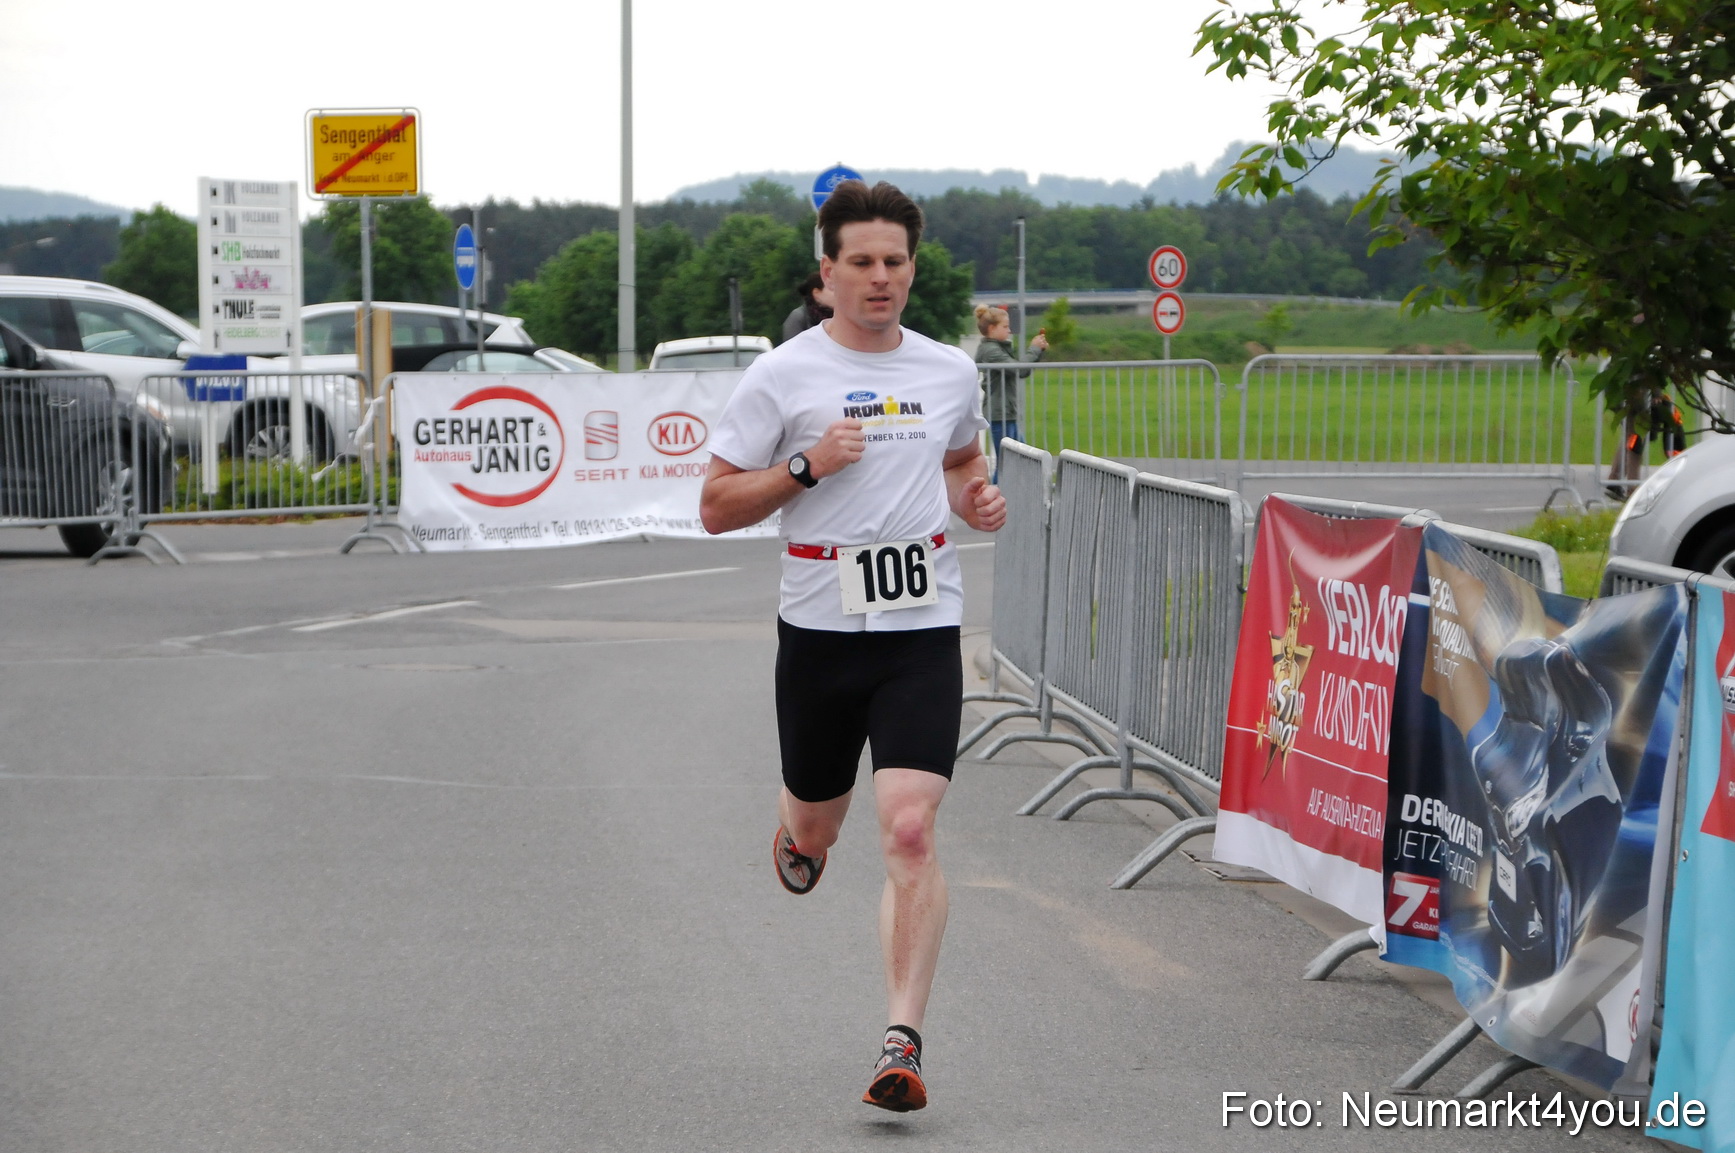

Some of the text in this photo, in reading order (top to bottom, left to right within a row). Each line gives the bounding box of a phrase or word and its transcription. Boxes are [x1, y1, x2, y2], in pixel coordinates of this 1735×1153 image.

[319, 123, 407, 149] Sengenthal
[1158, 258, 1178, 277] 60
[222, 299, 254, 319] THULE
[842, 394, 923, 419] IRONMAN
[414, 416, 547, 446] GERHART &
[657, 421, 697, 446] KIA
[863, 431, 927, 443] TEMBER 12, 2010
[413, 448, 472, 463] Autohaus
[470, 444, 551, 474] JÄNIG
[574, 468, 629, 482] SEAT
[639, 462, 709, 479] KIA MOTOR
[410, 523, 473, 542] Neumarkt
[478, 522, 541, 543] Sengenthal
[855, 543, 928, 603] 106
[1388, 879, 1430, 927] 7
[1429, 907, 1439, 918] KI
